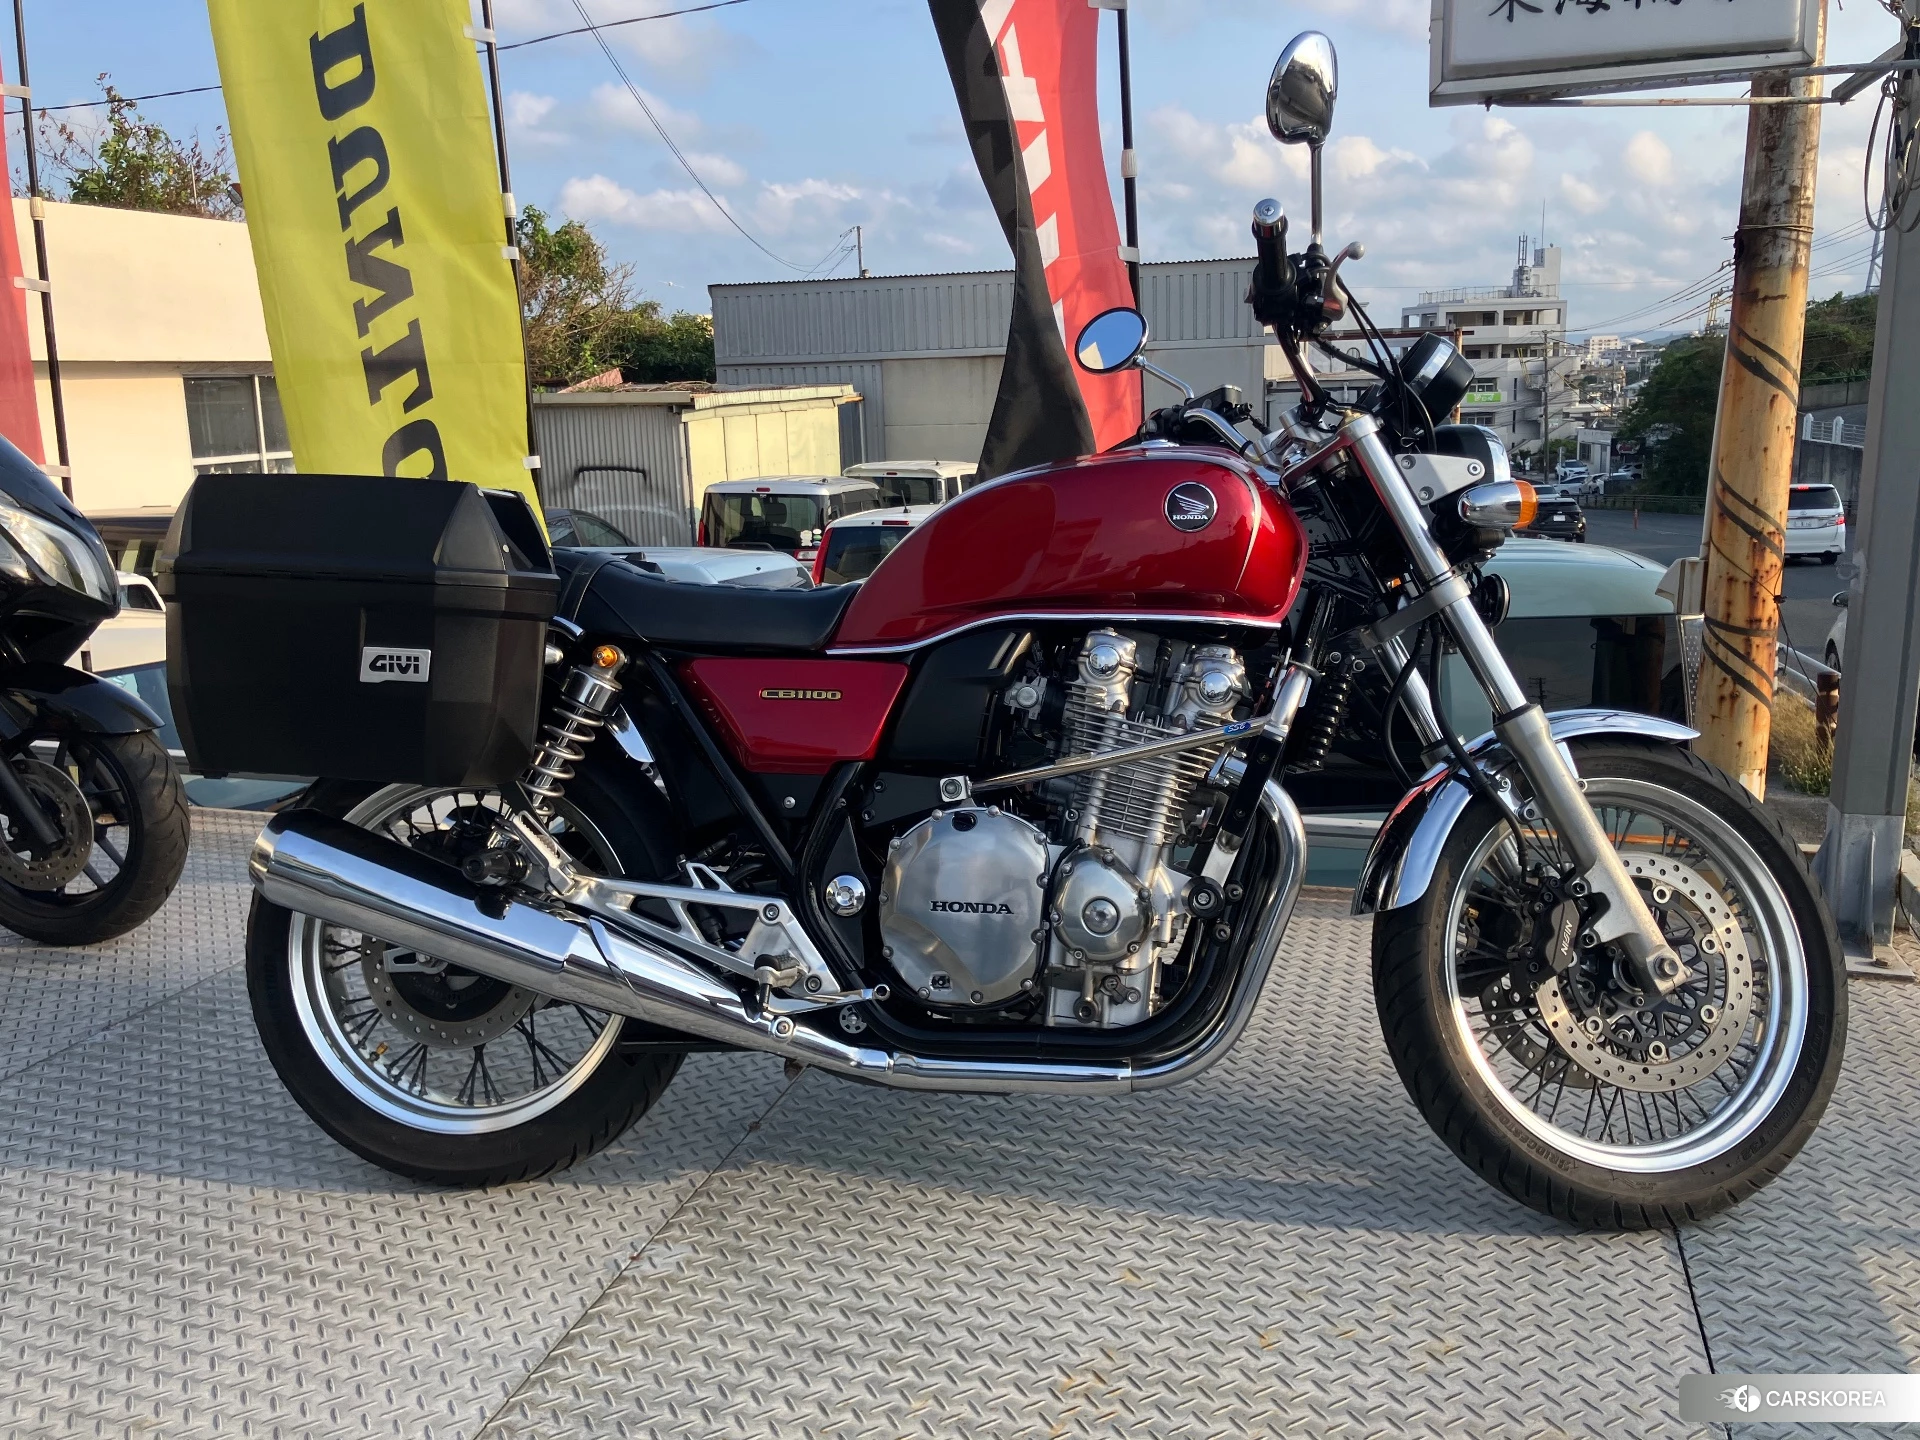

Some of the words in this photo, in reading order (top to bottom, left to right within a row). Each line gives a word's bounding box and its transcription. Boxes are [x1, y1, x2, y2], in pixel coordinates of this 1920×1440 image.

[369, 655, 419, 674] GIVI
[762, 689, 841, 699] CB1100
[929, 900, 1014, 914] HONDA
[1485, 1099, 1571, 1172] BRIDGESTONE
